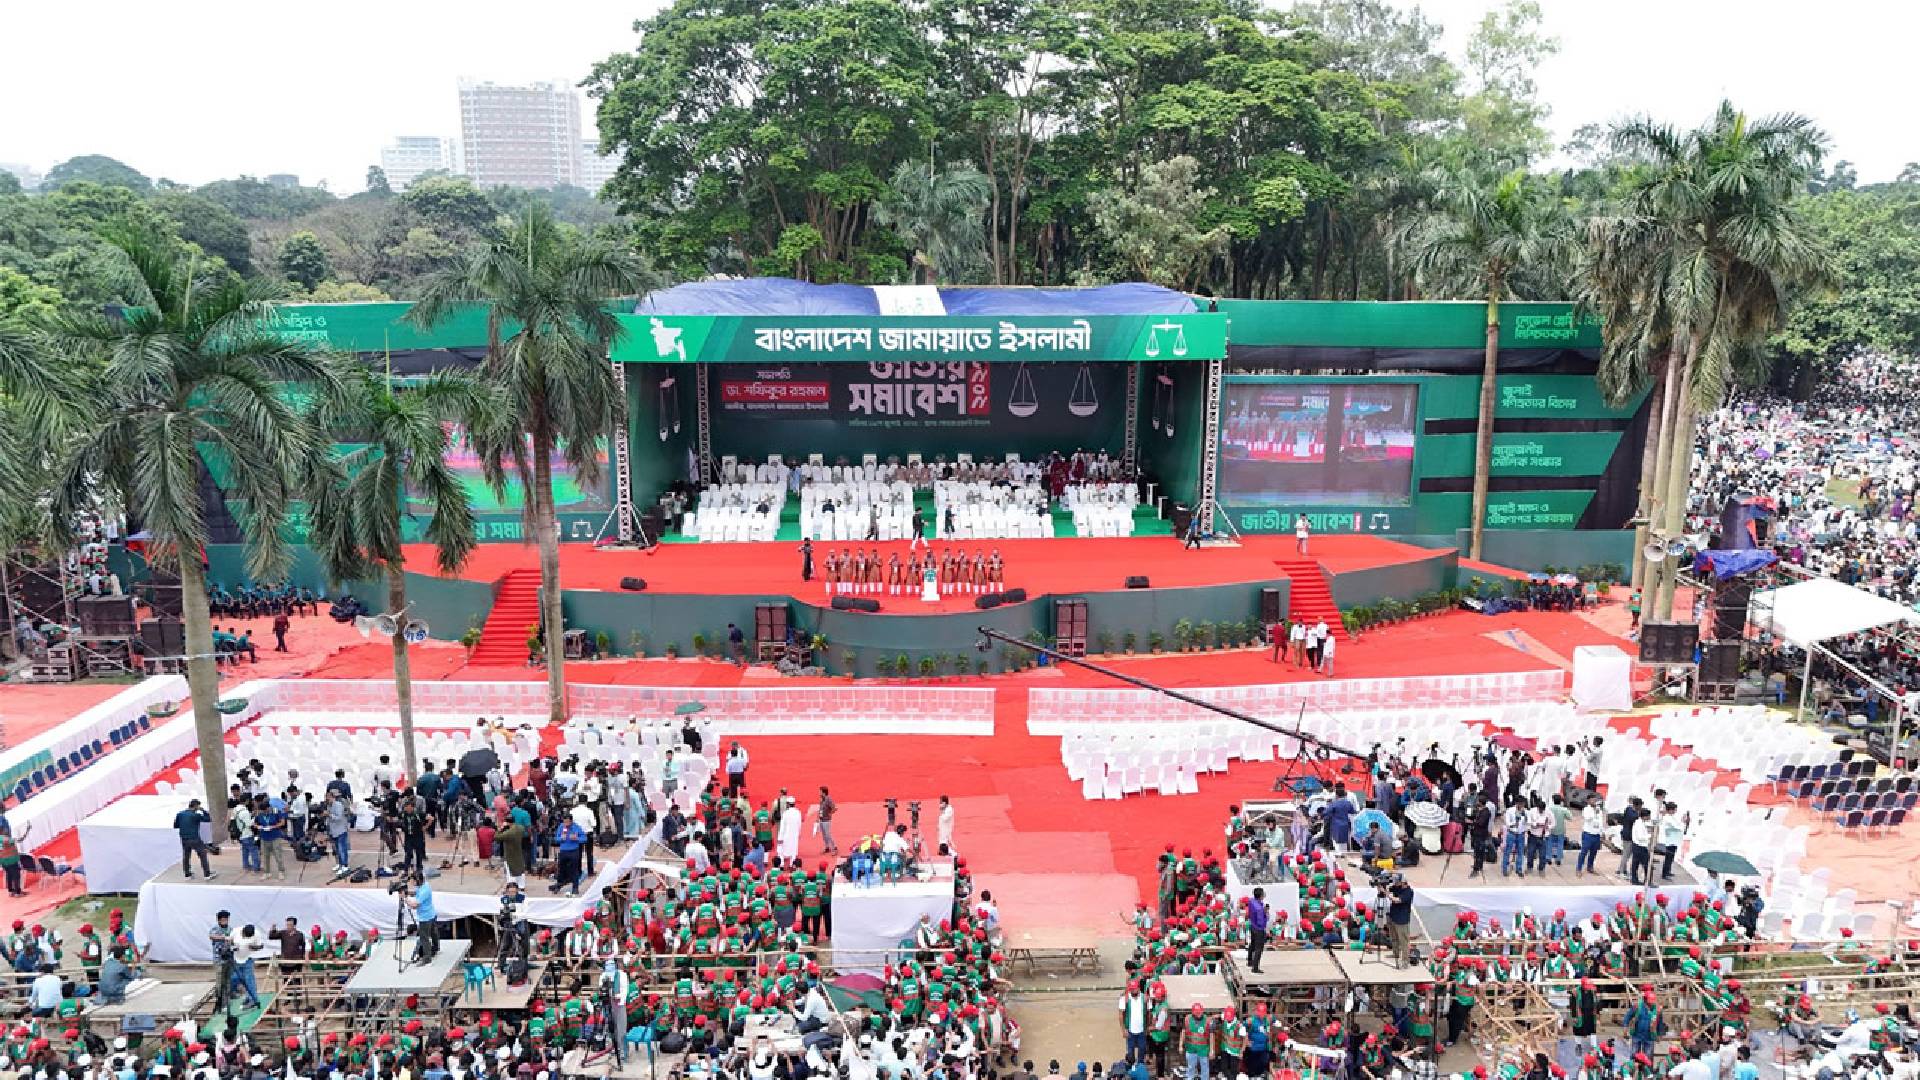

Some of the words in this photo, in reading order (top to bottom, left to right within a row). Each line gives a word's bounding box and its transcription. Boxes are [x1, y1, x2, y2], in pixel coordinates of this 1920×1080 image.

[754, 328, 872, 352] বাংলাদেশ
[879, 328, 992, 353] জামায়াতে
[999, 319, 1092, 352] ইসলামী
[744, 381, 787, 400] শফিকুর
[790, 385, 826, 397] রহমান
[848, 383, 966, 418] সমাবেশ
[1241, 509, 1291, 532] জাতীয়
